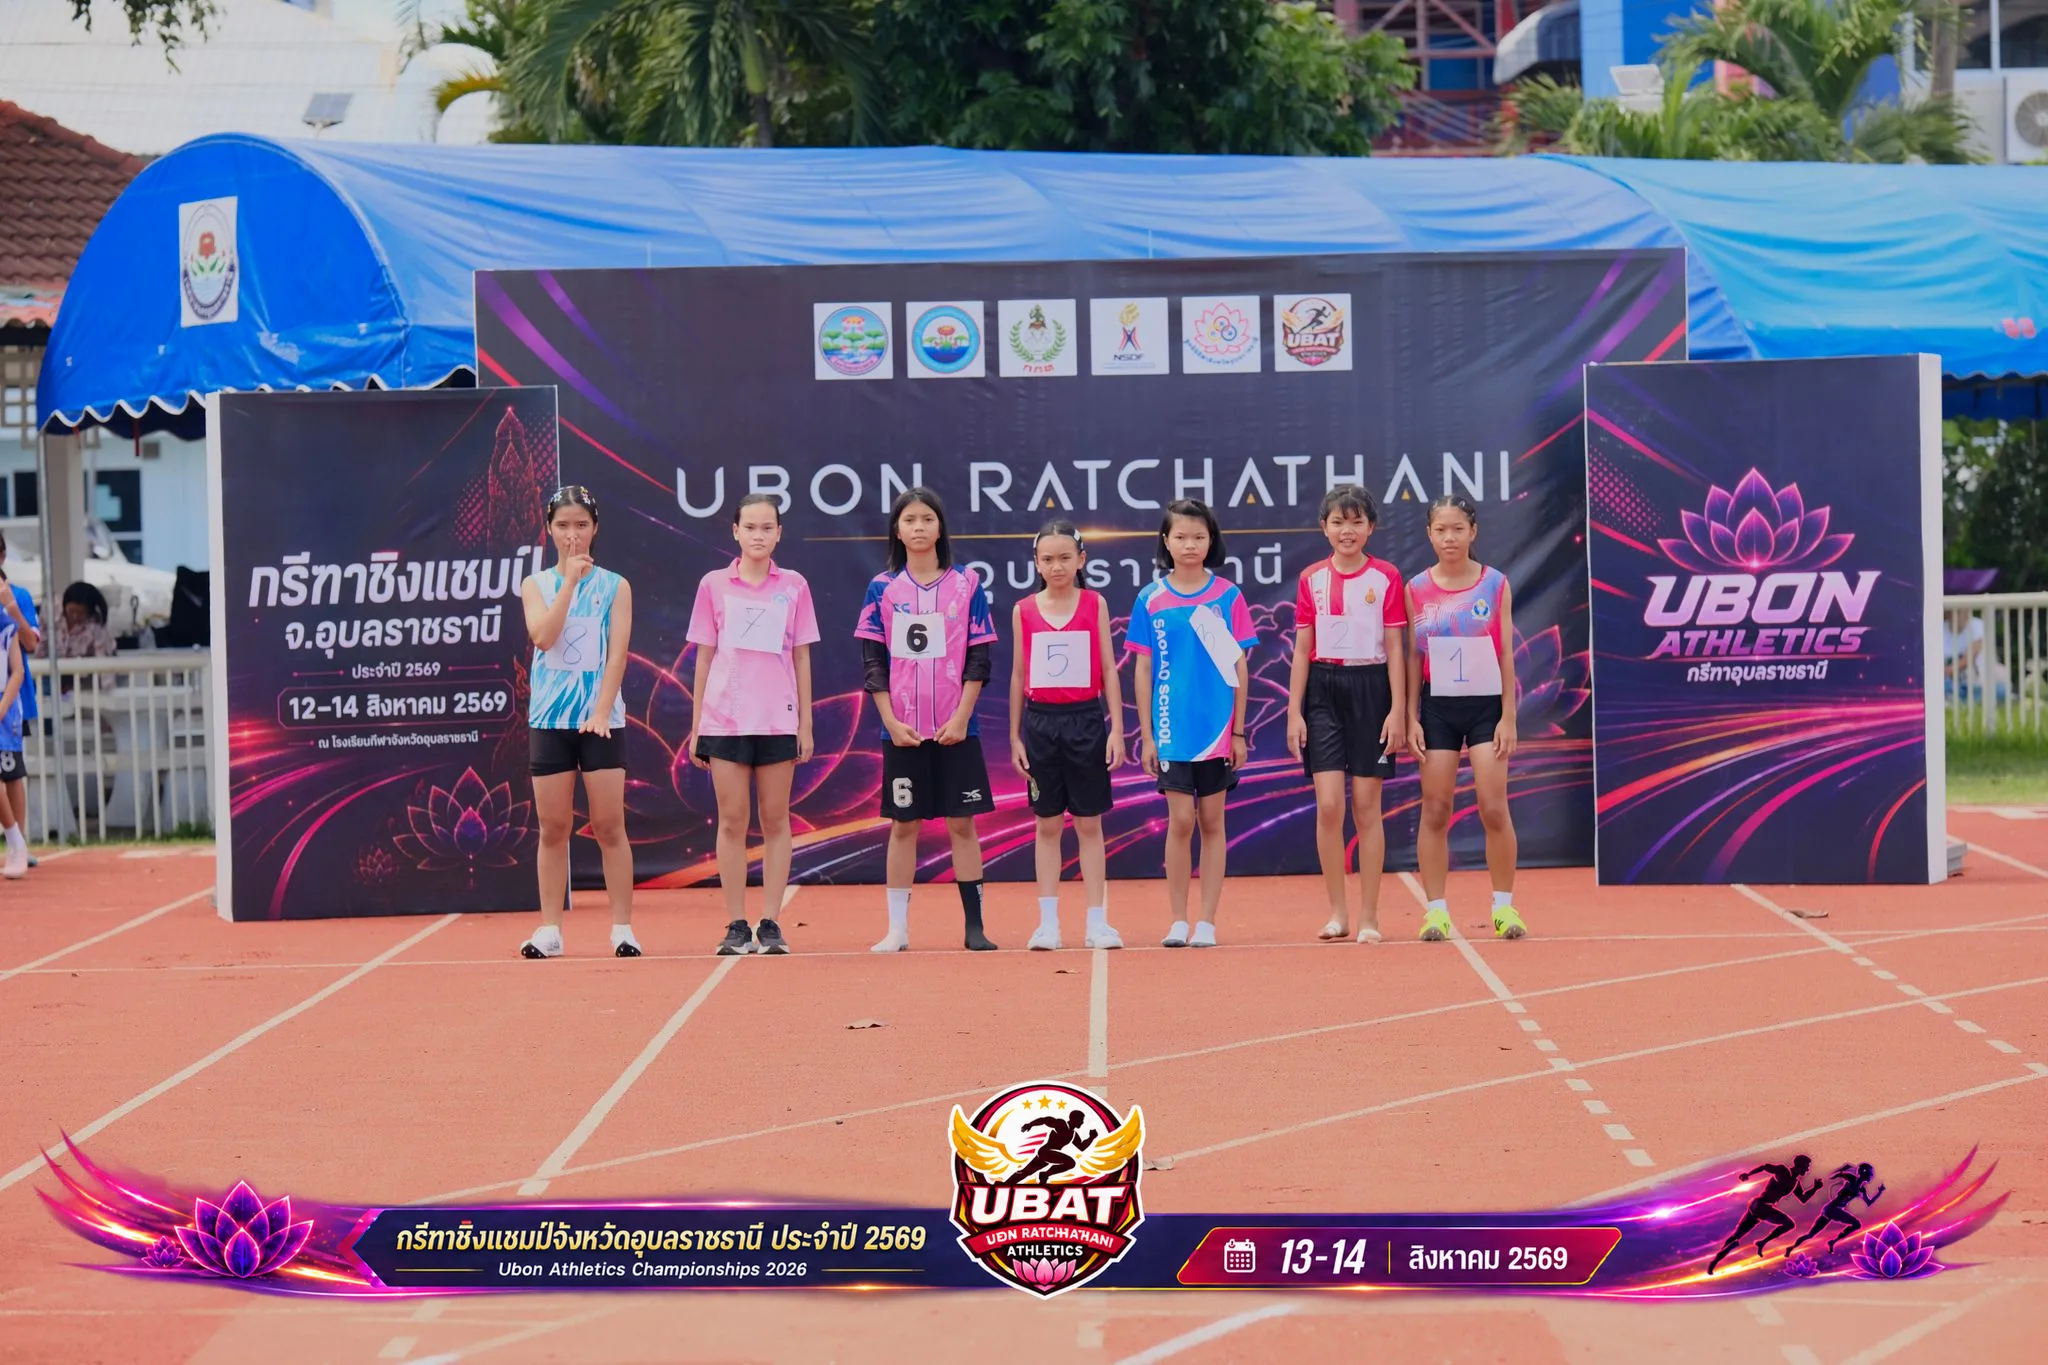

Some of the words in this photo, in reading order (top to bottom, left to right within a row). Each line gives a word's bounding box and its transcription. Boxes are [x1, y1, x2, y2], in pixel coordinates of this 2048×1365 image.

[1287, 332, 1341, 348] UBAT
[676, 463, 922, 518] UBON
[970, 450, 1510, 512] RATCHATHANI
[1643, 570, 1882, 627] UBON
[284, 604, 502, 660] จ.อุบลราชธานี
[740, 607, 766, 639] 7
[906, 623, 928, 653] 6
[1330, 621, 1352, 650] 2
[563, 624, 588, 665] 8
[1152, 618, 1170, 681] SAOLAO
[1648, 627, 1870, 659] ATHLETICS
[351, 661, 401, 679] ประจำปี
[405, 661, 441, 677] 2569
[1047, 643, 1069, 678] 5
[1449, 647, 1470, 683] 1
[1686, 659, 1828, 687] กรีฑาอุบลราชธานี
[288, 694, 359, 721] 12-14
[366, 693, 446, 718] สิงหาคม
[453, 690, 507, 714] 2569
[1158, 684, 1172, 748] SCHOOL
[892, 777, 913, 808] 6
